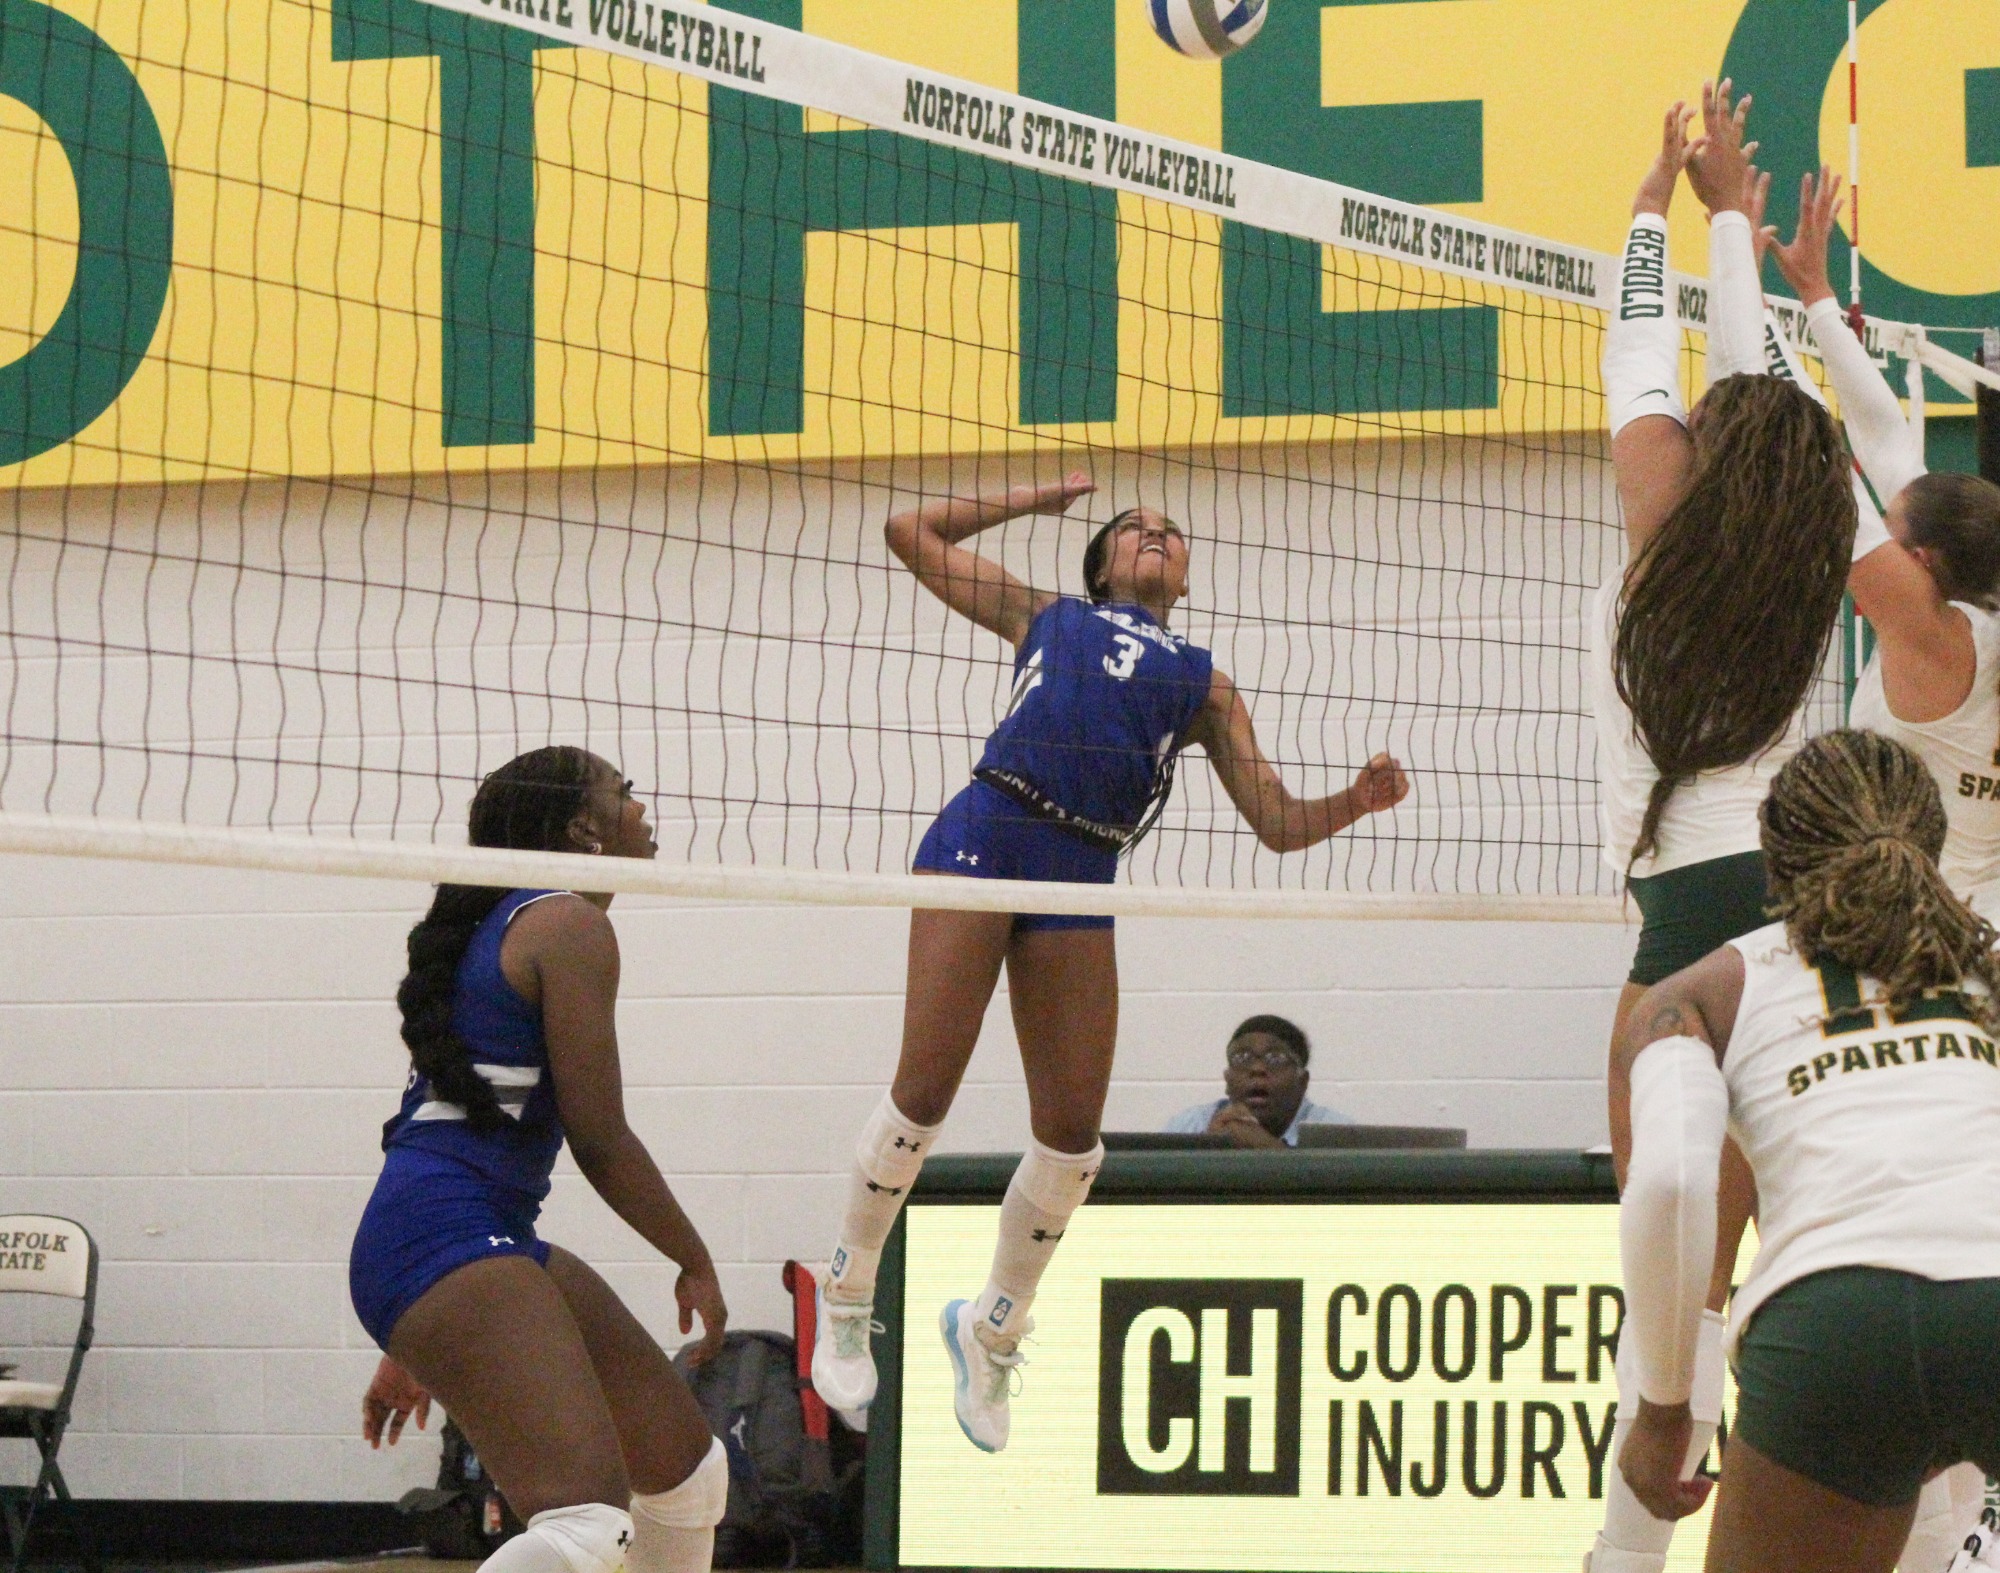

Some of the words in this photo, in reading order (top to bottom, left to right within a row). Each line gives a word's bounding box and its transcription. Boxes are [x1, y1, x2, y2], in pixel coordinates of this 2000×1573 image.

[588, 0, 766, 83] VOLLEYBALL
[903, 78, 1015, 149] NORFOLK
[1021, 112, 1096, 169] STATE
[1104, 133, 1237, 208] VOLLEYBALL
[1340, 197, 1427, 256] NORFOLK
[1430, 222, 1487, 271] STATE
[1492, 238, 1596, 297] VOLLEYBALL
[1620, 228, 1665, 321] BEHOLD
[1102, 634, 1145, 681] 3
[1787, 1033, 2000, 1097] SPARTAN
[1326, 1283, 1627, 1383] COOPER
[1121, 1306, 1279, 1473] CH
[1326, 1400, 1617, 1498] INJURY
